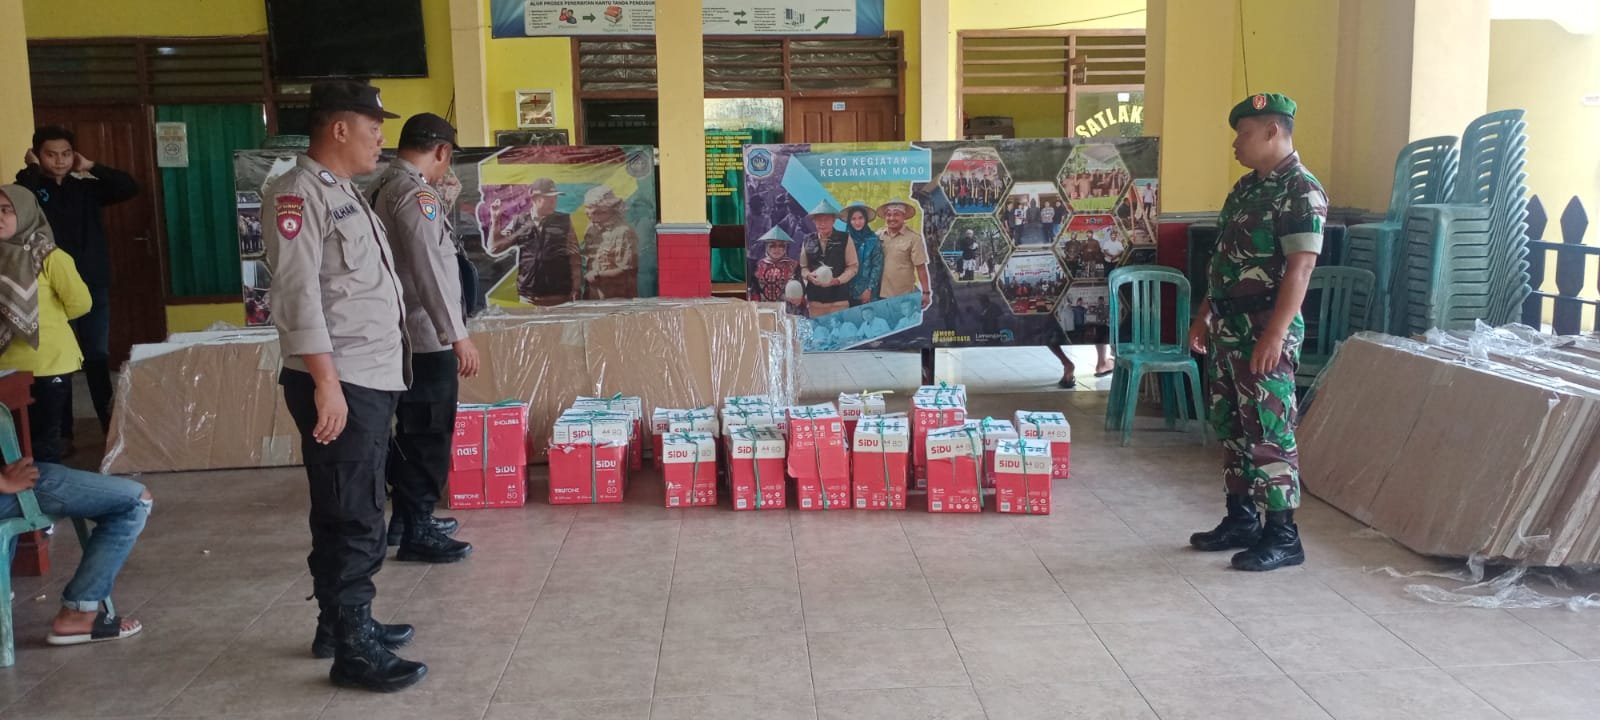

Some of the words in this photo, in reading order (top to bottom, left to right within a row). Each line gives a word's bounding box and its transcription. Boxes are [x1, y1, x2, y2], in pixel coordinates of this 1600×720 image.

[1075, 104, 1143, 138] SATLAK
[820, 158, 847, 167] FOTO
[853, 156, 908, 166] KEGIATAN
[820, 167, 887, 177] KECAMATAN
[893, 166, 924, 175] MODO
